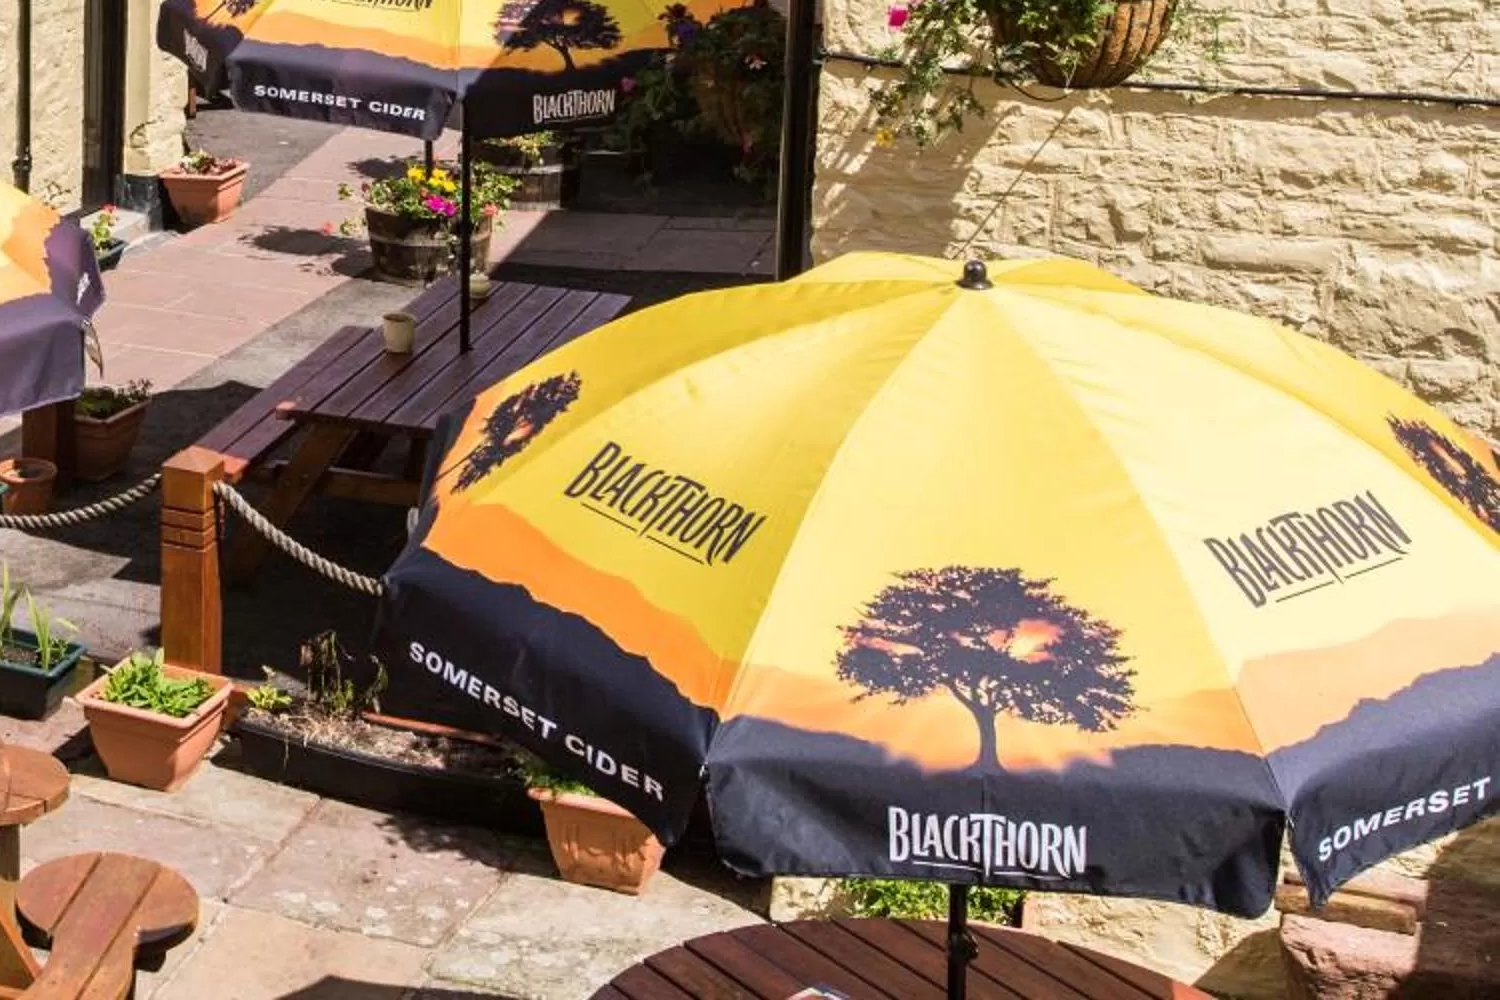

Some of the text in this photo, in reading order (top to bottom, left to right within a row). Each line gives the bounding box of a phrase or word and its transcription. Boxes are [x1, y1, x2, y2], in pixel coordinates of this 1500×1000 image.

[254, 85, 426, 121] SOMERSET CIDER
[533, 89, 616, 124] BLACKTHORN
[563, 442, 768, 566] BLACKTHORN
[1202, 490, 1414, 610] BLACKTHORN
[408, 641, 666, 802] SOMERSET CIDER
[888, 806, 1088, 878] BLACKTHORN
[1318, 777, 1491, 862] SOMERSET
